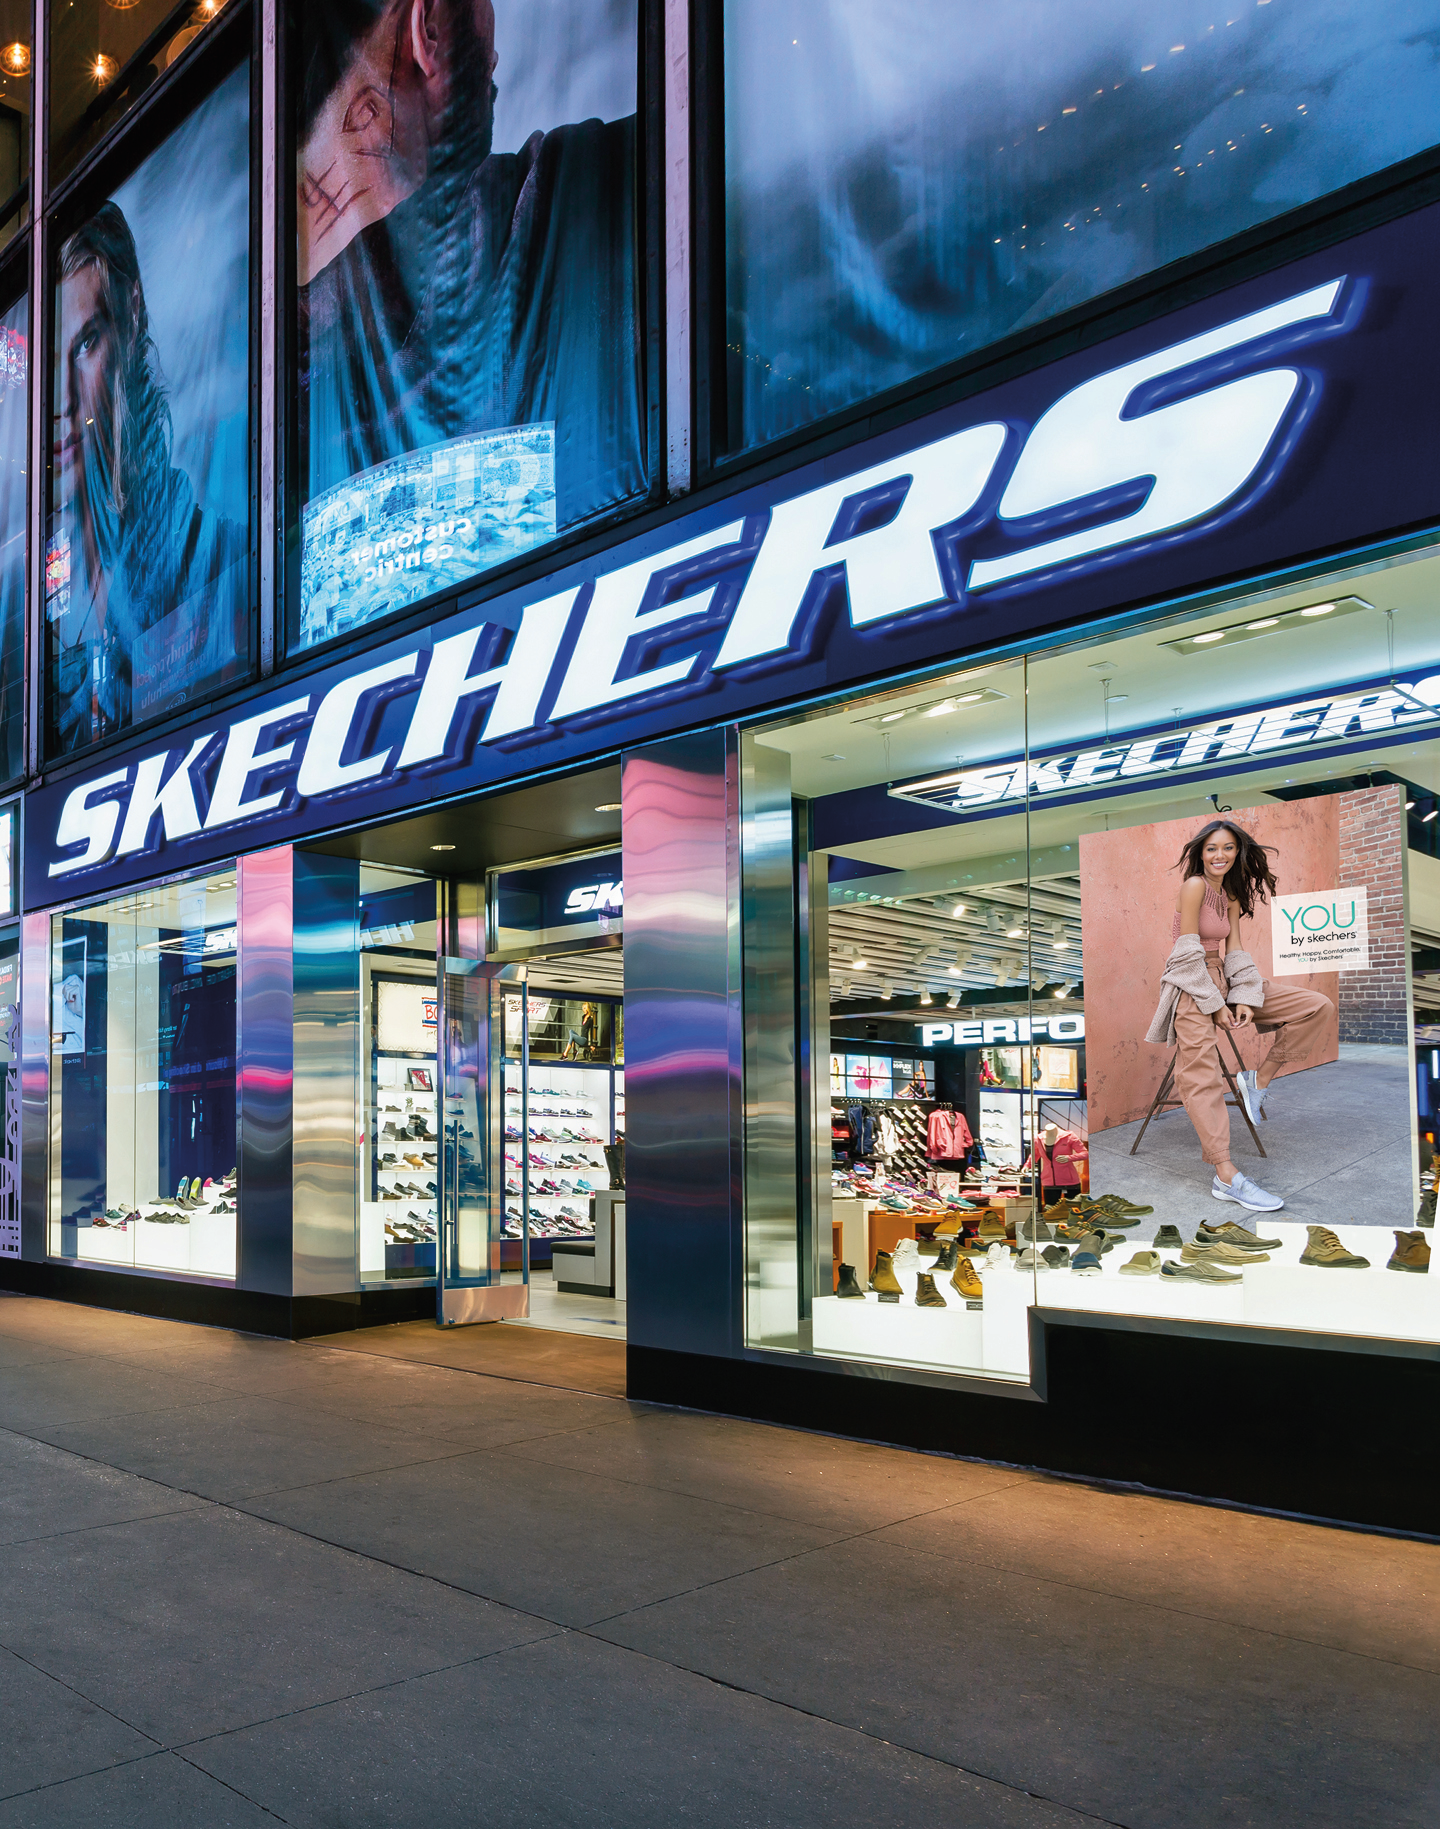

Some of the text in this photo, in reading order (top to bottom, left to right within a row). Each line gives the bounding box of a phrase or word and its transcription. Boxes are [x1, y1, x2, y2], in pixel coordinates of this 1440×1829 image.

[47, 276, 1348, 878] SKECHERS
[1281, 901, 1355, 934] YOU
[1291, 931, 1356, 946] by skechers
[507, 999, 546, 1008] SKEHERS
[509, 1005, 541, 1014] SPRT
